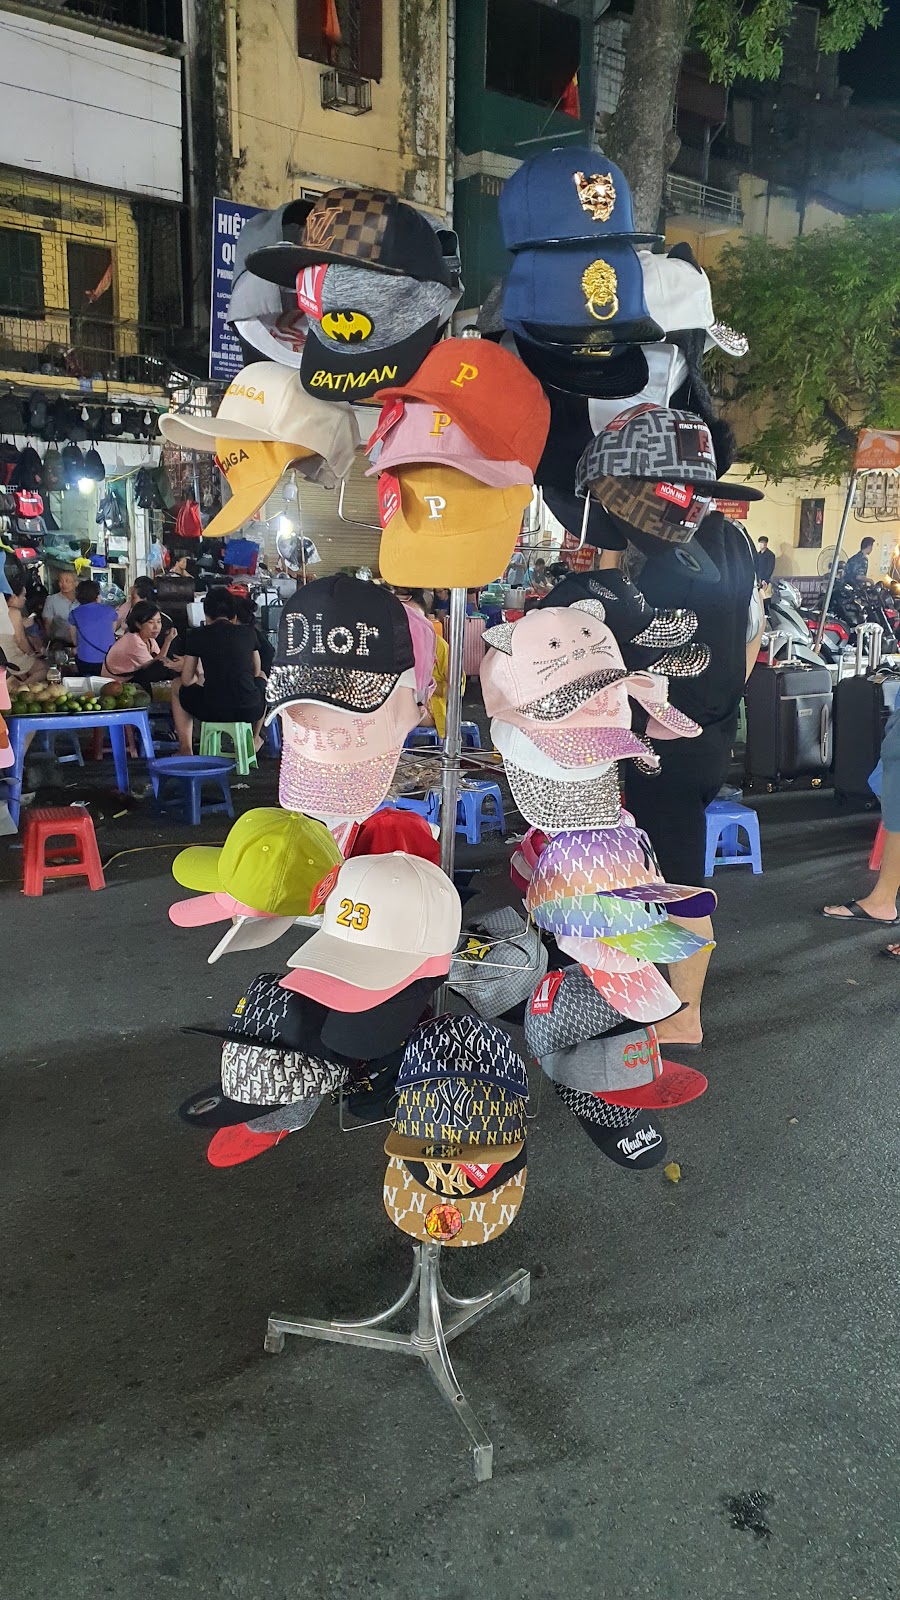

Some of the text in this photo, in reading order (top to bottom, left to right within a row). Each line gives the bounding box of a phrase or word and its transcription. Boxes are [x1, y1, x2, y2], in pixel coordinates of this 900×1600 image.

[310, 365, 397, 393] BATMAN
[450, 362, 479, 387] P
[227, 383, 265, 405] CIAGA
[429, 411, 451, 436] P
[660, 485, 687, 502] NÓN NHI
[424, 496, 446, 519] P
[286, 612, 379, 656] Dior
[336, 898, 371, 931] 23
